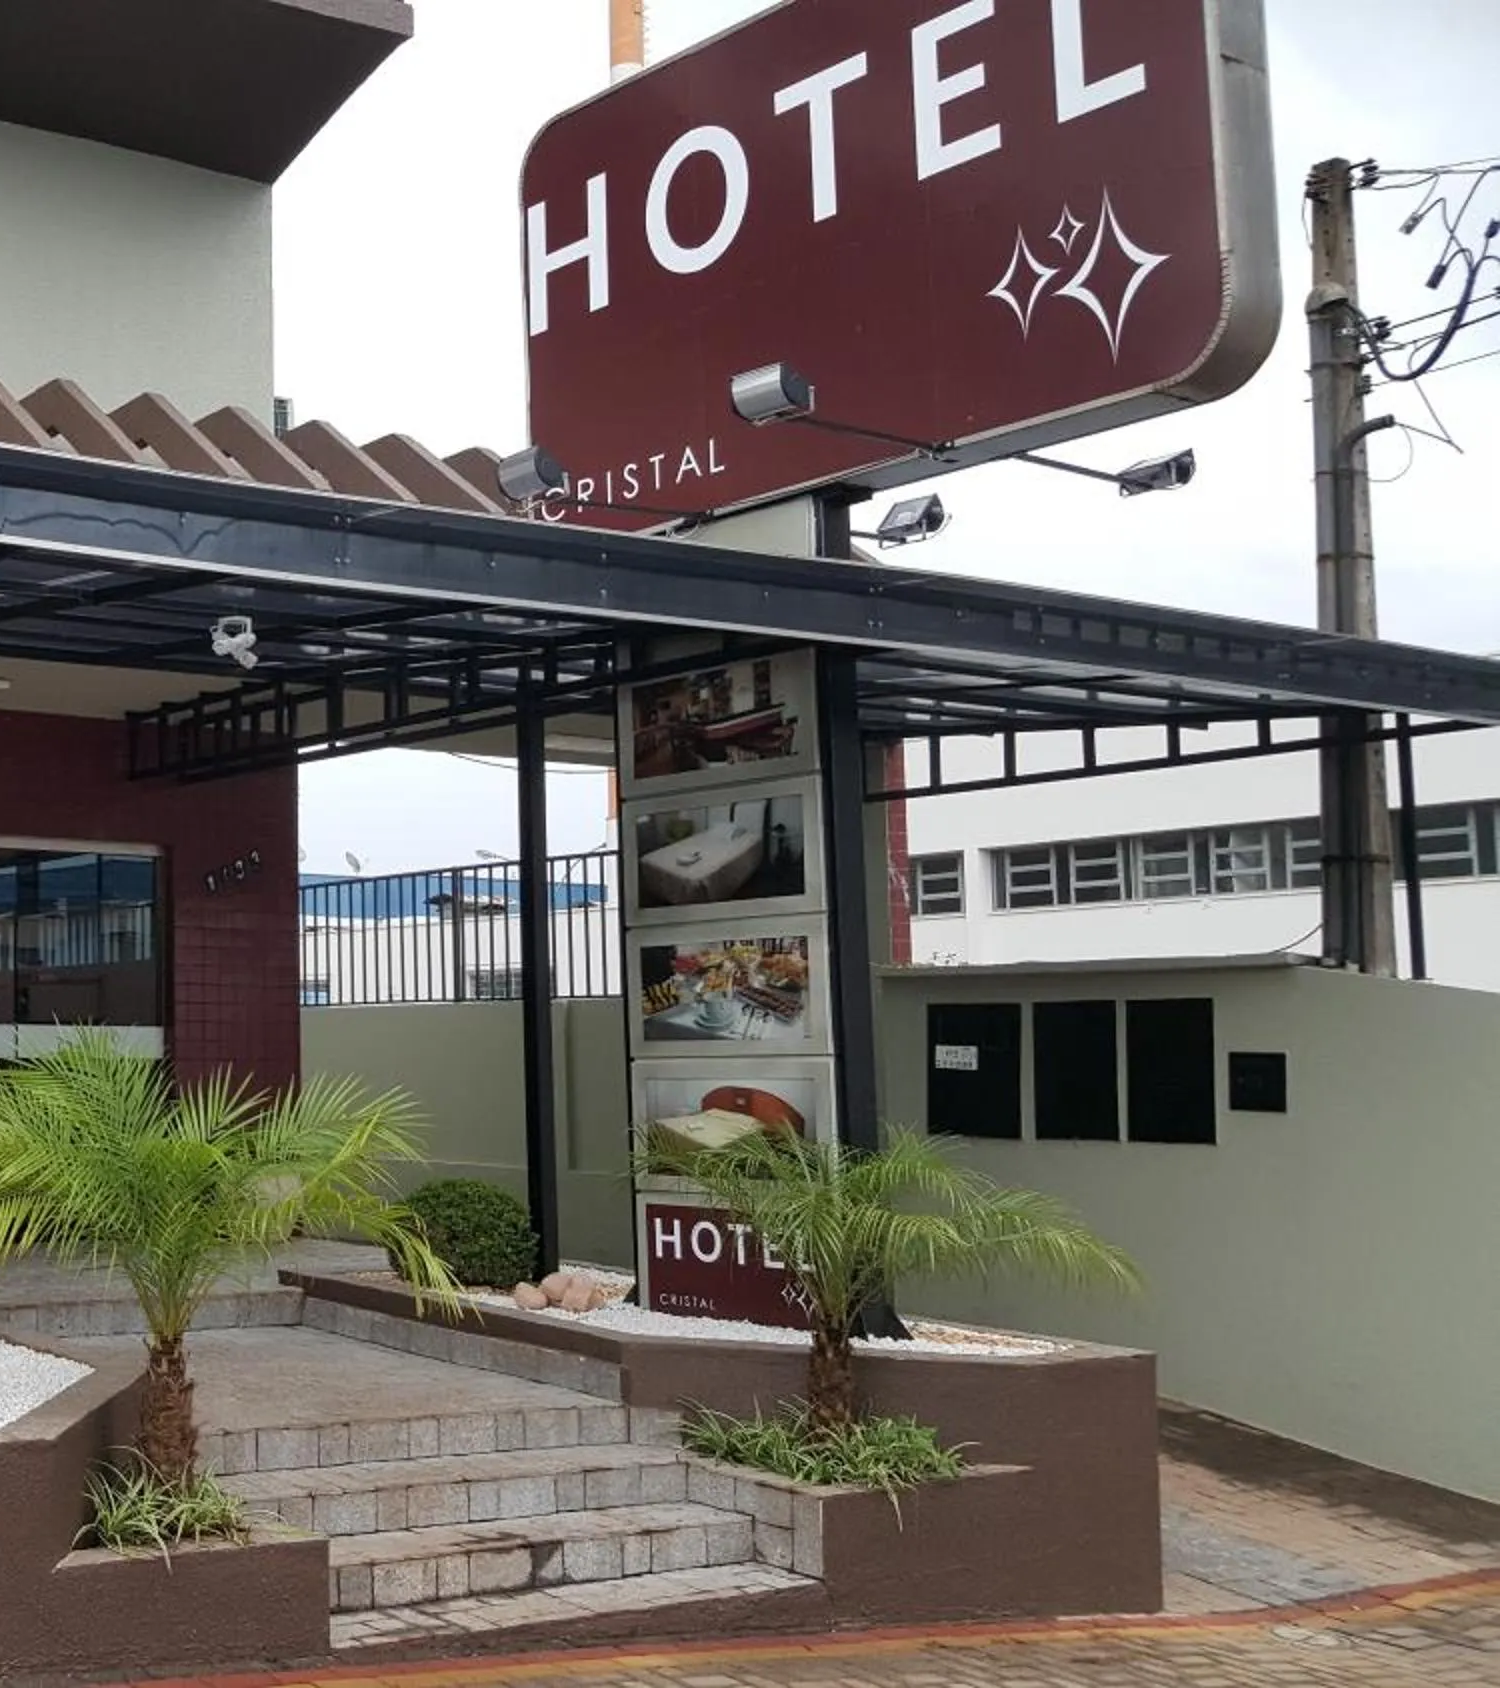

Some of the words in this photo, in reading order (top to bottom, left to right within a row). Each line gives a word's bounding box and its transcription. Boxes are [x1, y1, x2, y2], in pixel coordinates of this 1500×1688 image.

[526, 0, 1146, 337] HOTEL
[541, 438, 725, 521] CRISTAL
[654, 1216, 816, 1271] HOTEL
[659, 1292, 716, 1311] CRISTAL
